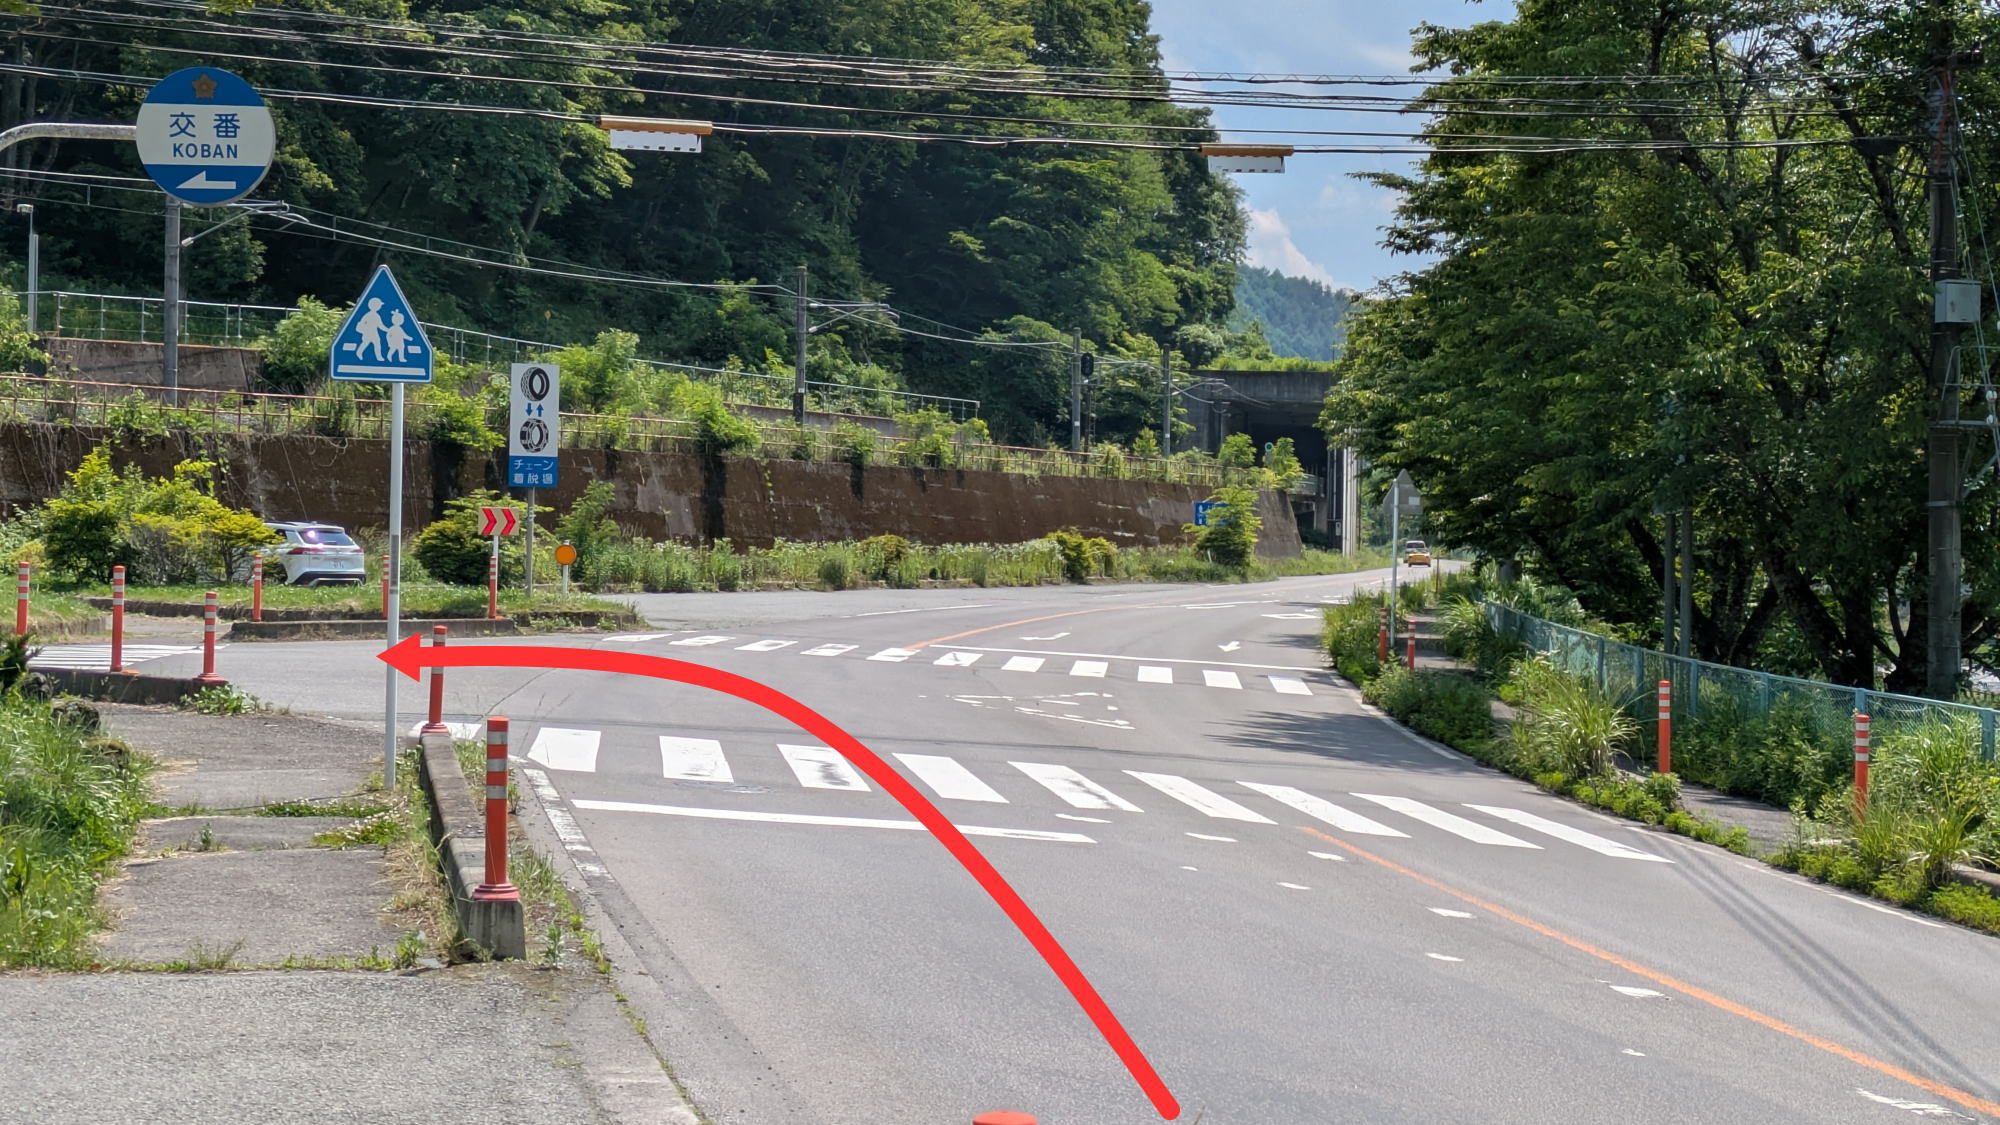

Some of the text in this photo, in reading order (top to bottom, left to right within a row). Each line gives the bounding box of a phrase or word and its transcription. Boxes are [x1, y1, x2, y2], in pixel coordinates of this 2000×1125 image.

[169, 111, 241, 139] 交番
[172, 142, 238, 159] KOBAN
[513, 459, 554, 471] チェーン
